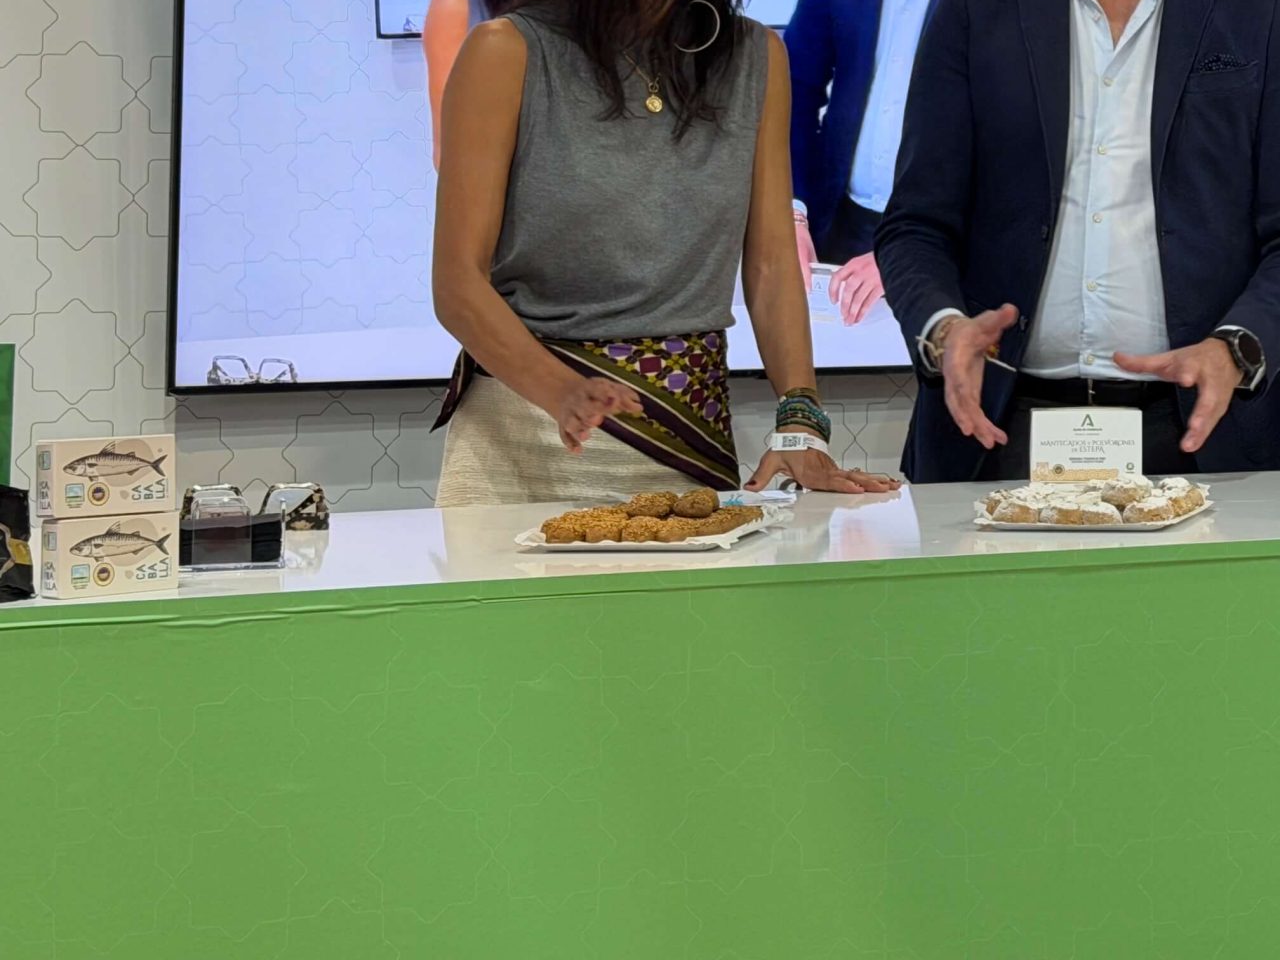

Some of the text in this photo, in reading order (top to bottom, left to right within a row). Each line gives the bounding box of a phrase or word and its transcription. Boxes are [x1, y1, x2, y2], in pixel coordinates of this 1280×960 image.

[132, 484, 142, 500] CA
[144, 483, 154, 500] BA
[155, 478, 165, 499] LLA
[136, 564, 146, 580] CA
[147, 563, 158, 579] BA
[159, 557, 169, 578] LLA
